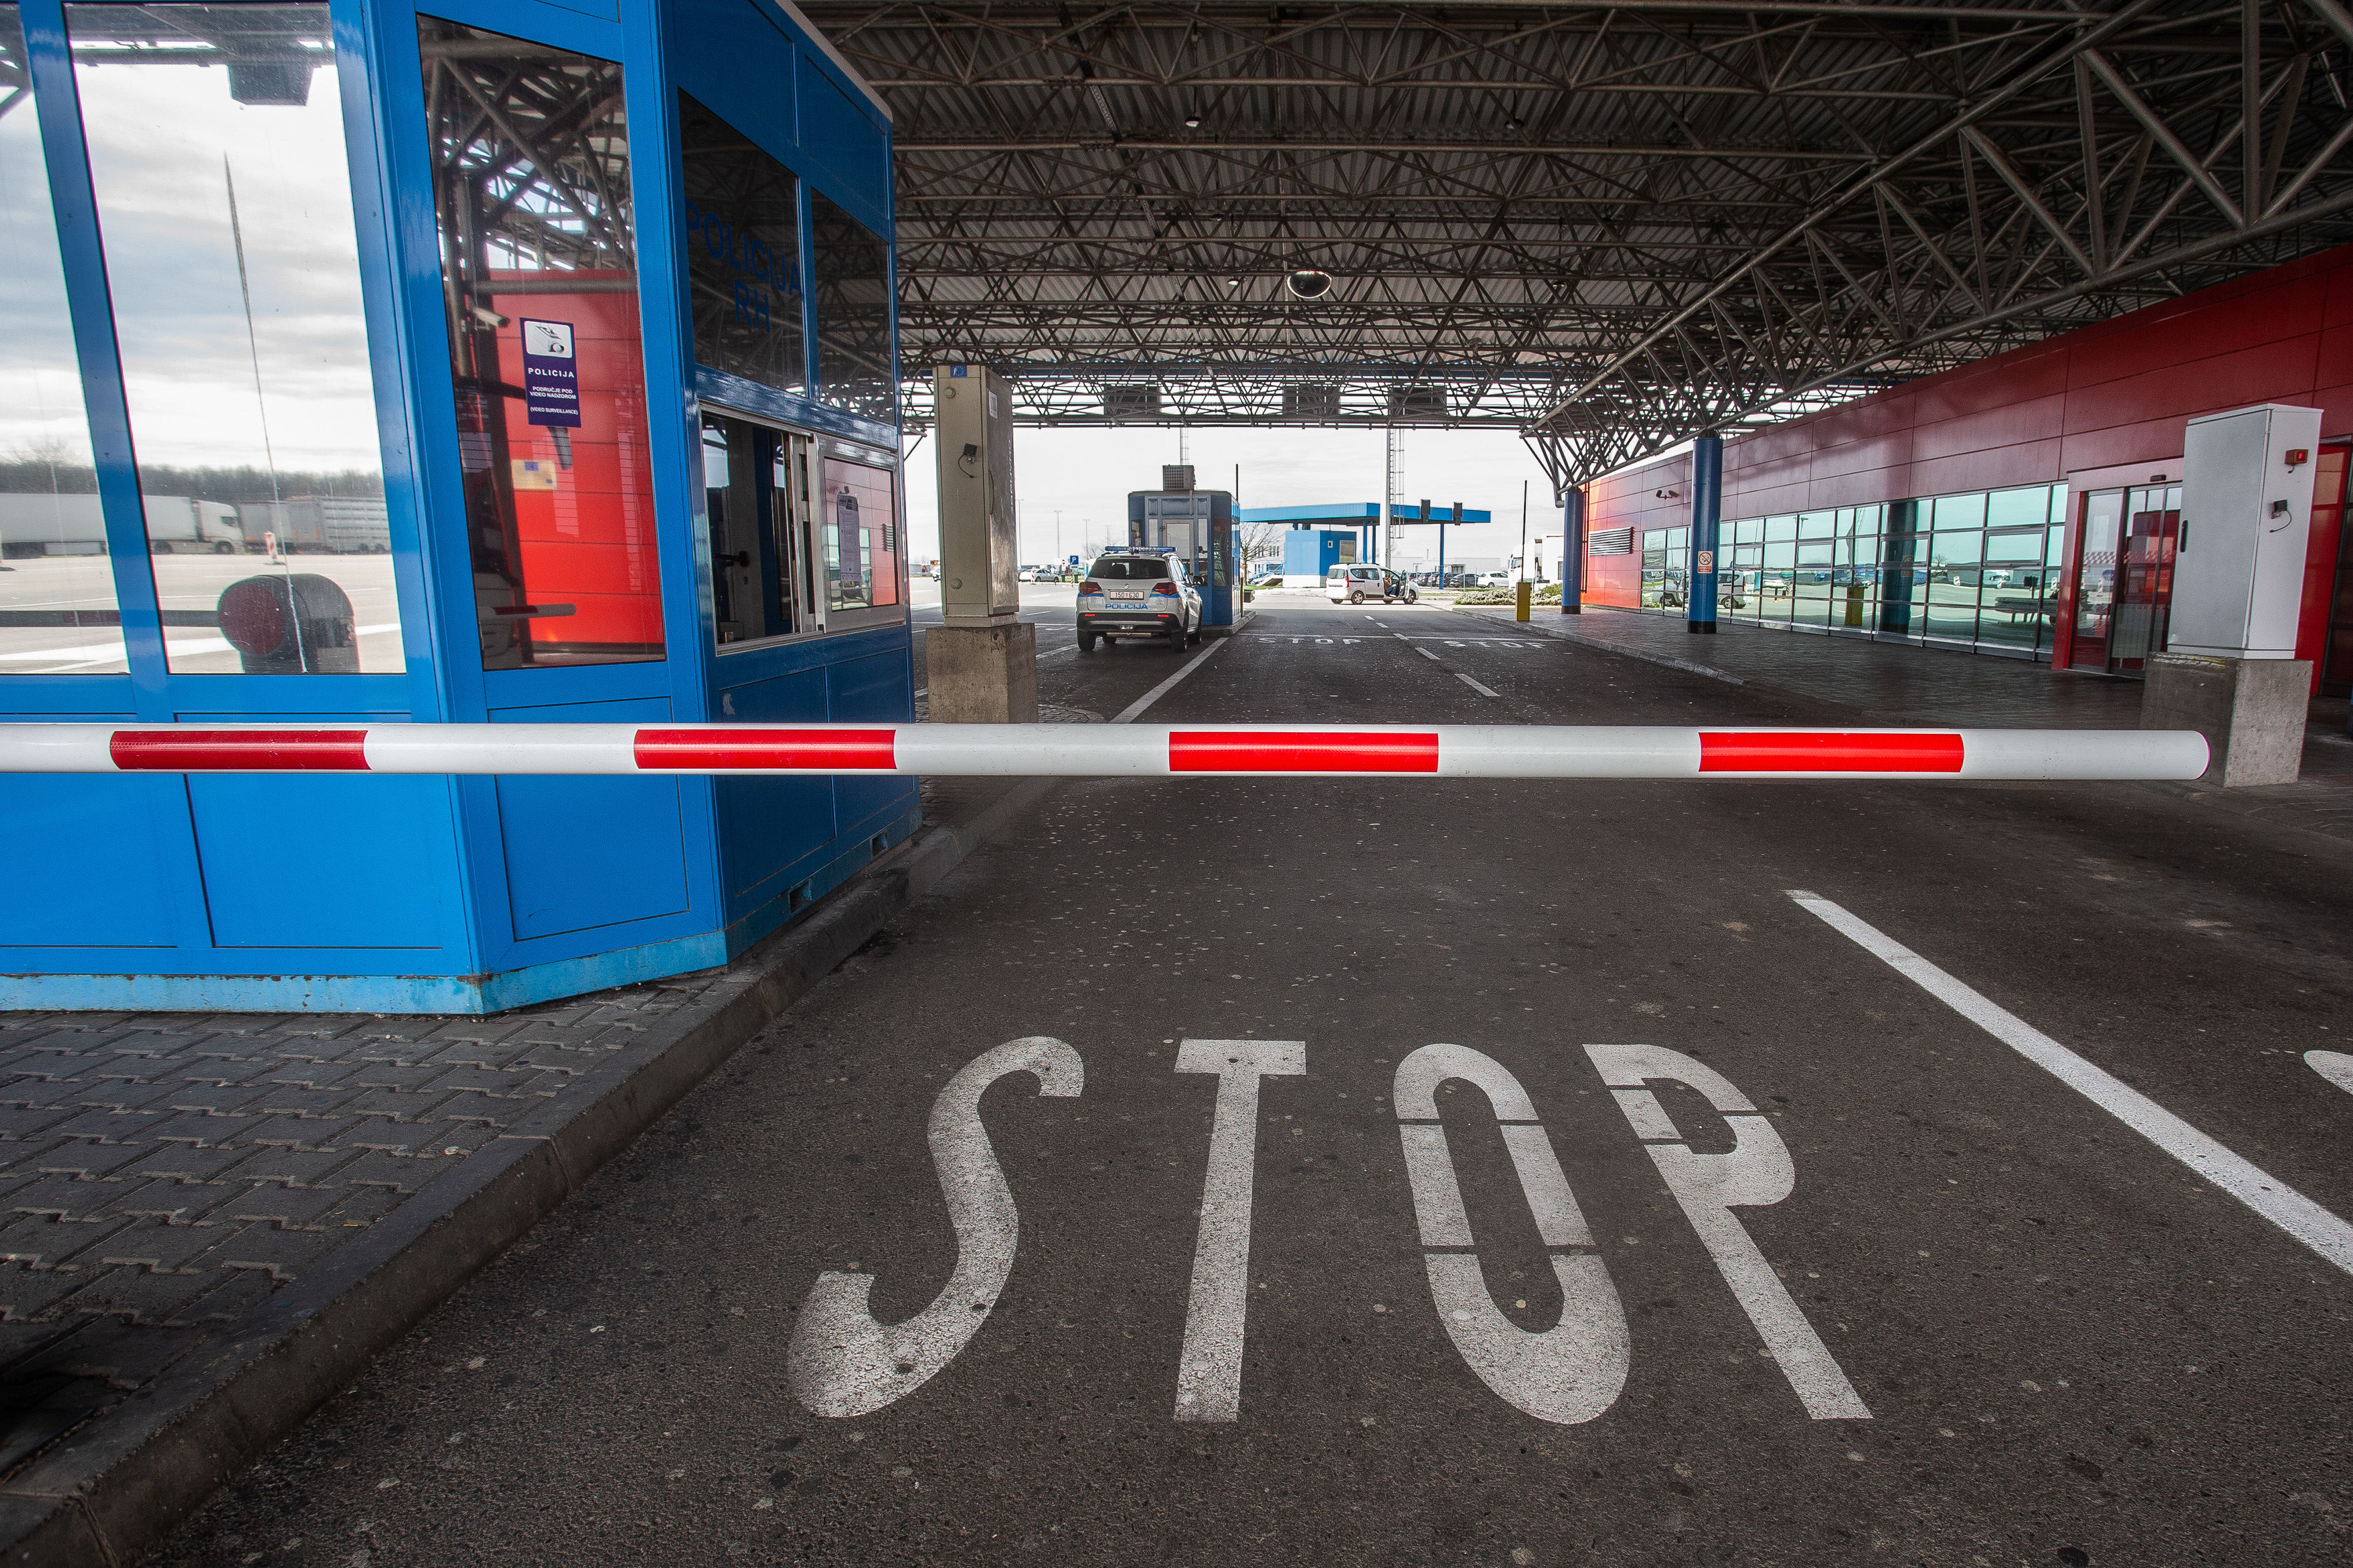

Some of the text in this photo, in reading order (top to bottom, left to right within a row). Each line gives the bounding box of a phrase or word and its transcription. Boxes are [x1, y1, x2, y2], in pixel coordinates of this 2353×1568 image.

[685, 198, 805, 302] POLICIJA
[734, 278, 770, 333] RH
[528, 367, 575, 378] POLICIJA
[545, 407, 579, 416] SURVEILLANCE)
[787, 1036, 1874, 1424] STOP
